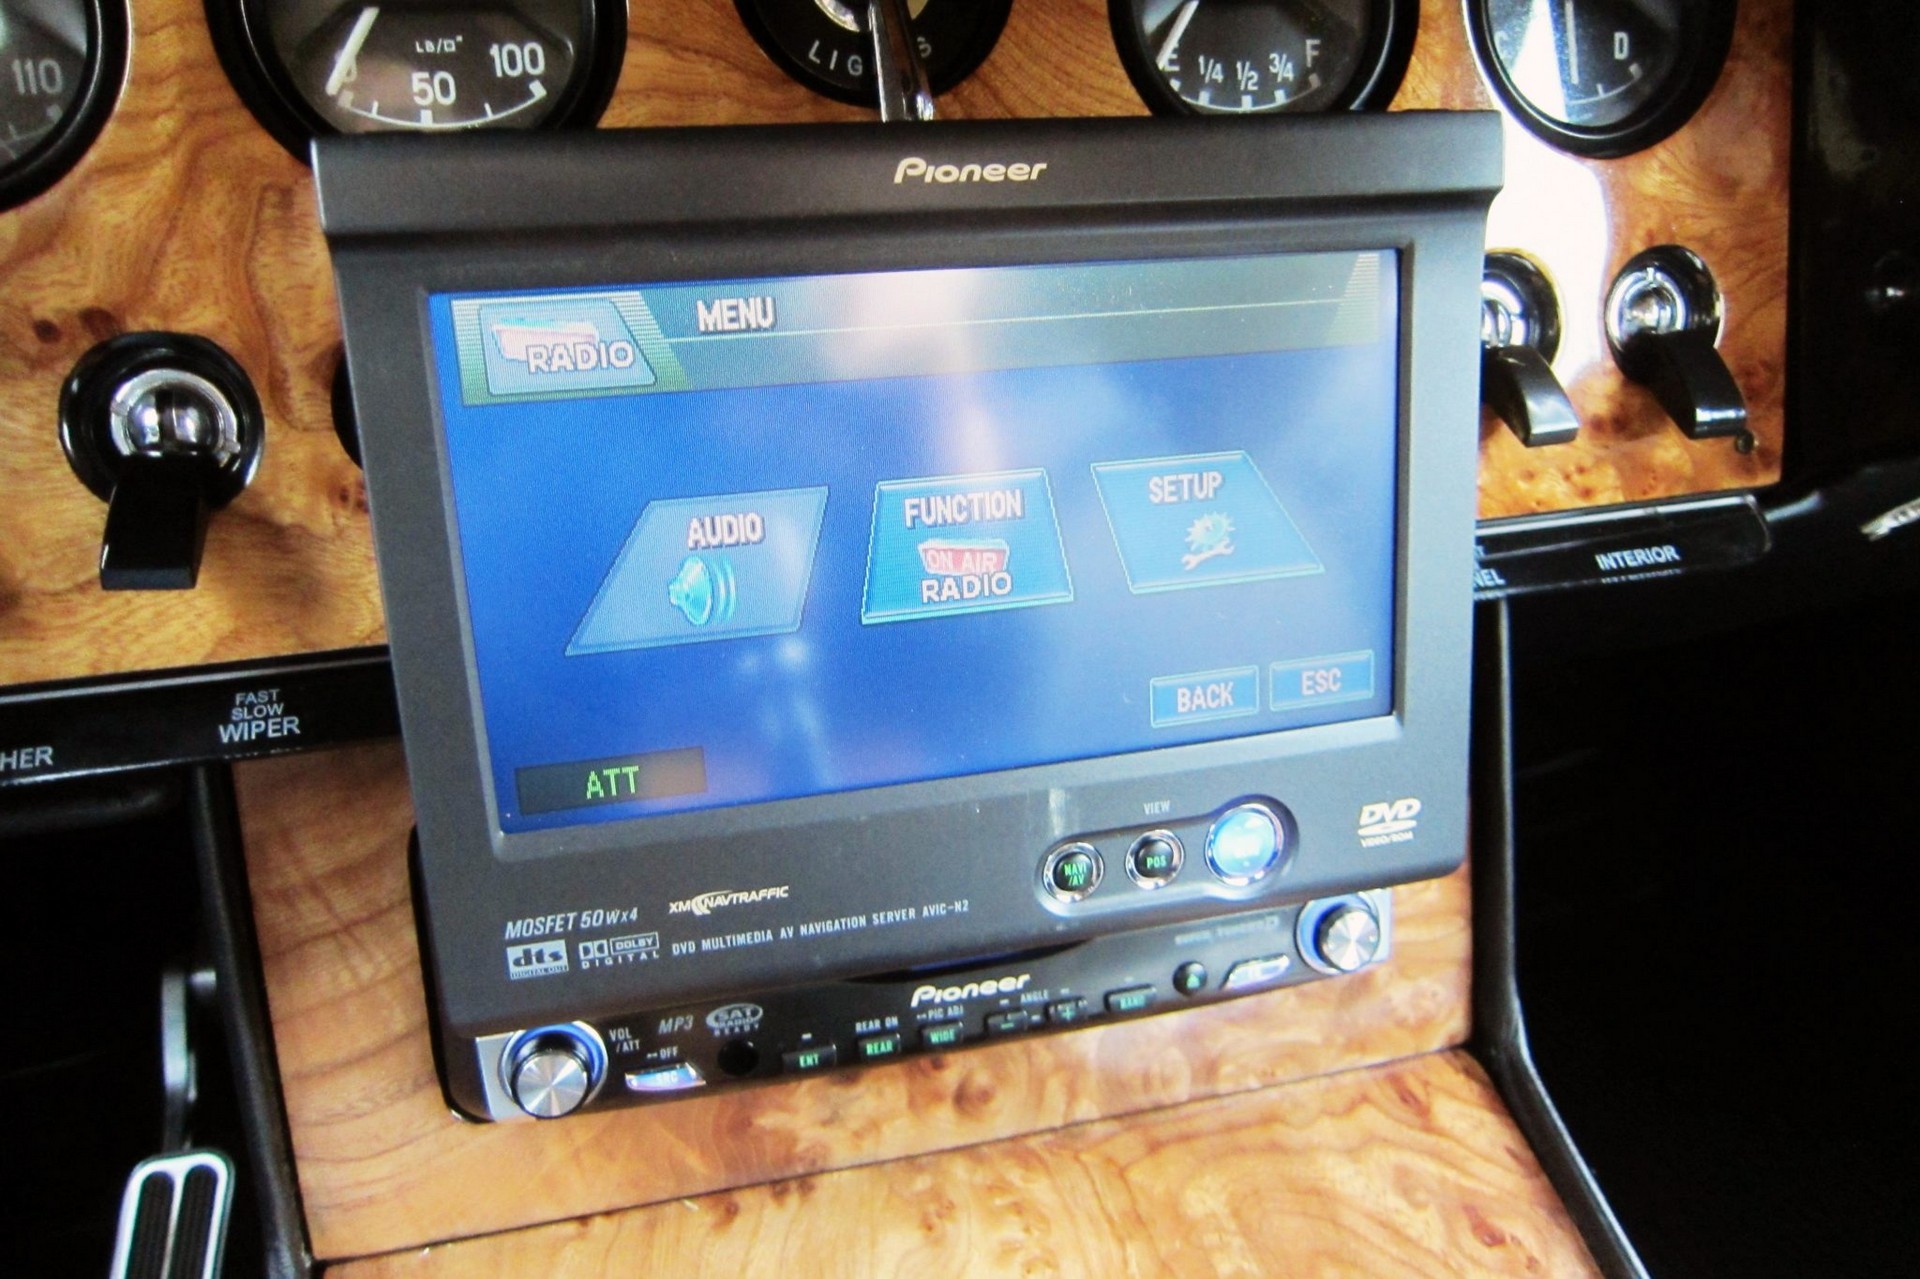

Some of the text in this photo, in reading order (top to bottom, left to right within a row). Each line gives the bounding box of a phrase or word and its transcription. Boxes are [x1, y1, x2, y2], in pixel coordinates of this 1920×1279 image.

[490, 42, 545, 78] 100
[808, 36, 932, 76] LIGS
[1304, 39, 1321, 68] F
[1613, 31, 1630, 61] D
[11, 57, 63, 96] 110
[411, 71, 457, 106] 50
[893, 156, 1048, 185] Pioneer
[696, 297, 776, 333] MENU
[527, 341, 635, 374] RADIO
[1149, 471, 1224, 504] SETUP
[903, 489, 1024, 528] FUNCTION
[687, 512, 765, 549] AUDIO
[926, 549, 998, 574] ON AIR
[1595, 544, 1681, 571] INTERIOR
[921, 571, 1014, 604] RADIO
[1301, 668, 1342, 696] ESC
[231, 703, 284, 721] SLOW
[235, 689, 280, 706] FAST
[1176, 682, 1235, 713] BACK
[219, 717, 301, 743] WIPER
[586, 765, 640, 799] ATT
[1143, 800, 1171, 815] VIEW
[1359, 797, 1421, 826] DVD
[1146, 855, 1167, 869] POS
[504, 911, 577, 940] MOSFET
[672, 899, 970, 956] DVD MULTIMEDIA AV NAVIGATION SERVER AVIC-N2
[614, 936, 655, 951] DOLBY
[581, 950, 661, 969] DIGITAL
[910, 973, 1031, 1008] Pioneer
[609, 1027, 632, 1042] VOL
[658, 1014, 694, 1035] MP3
[855, 1018, 881, 1034] REAR
[930, 1029, 956, 1044] WIDE
[660, 1046, 679, 1059] OFF
[799, 1053, 820, 1069] ENT
[866, 1040, 893, 1056] REAR
